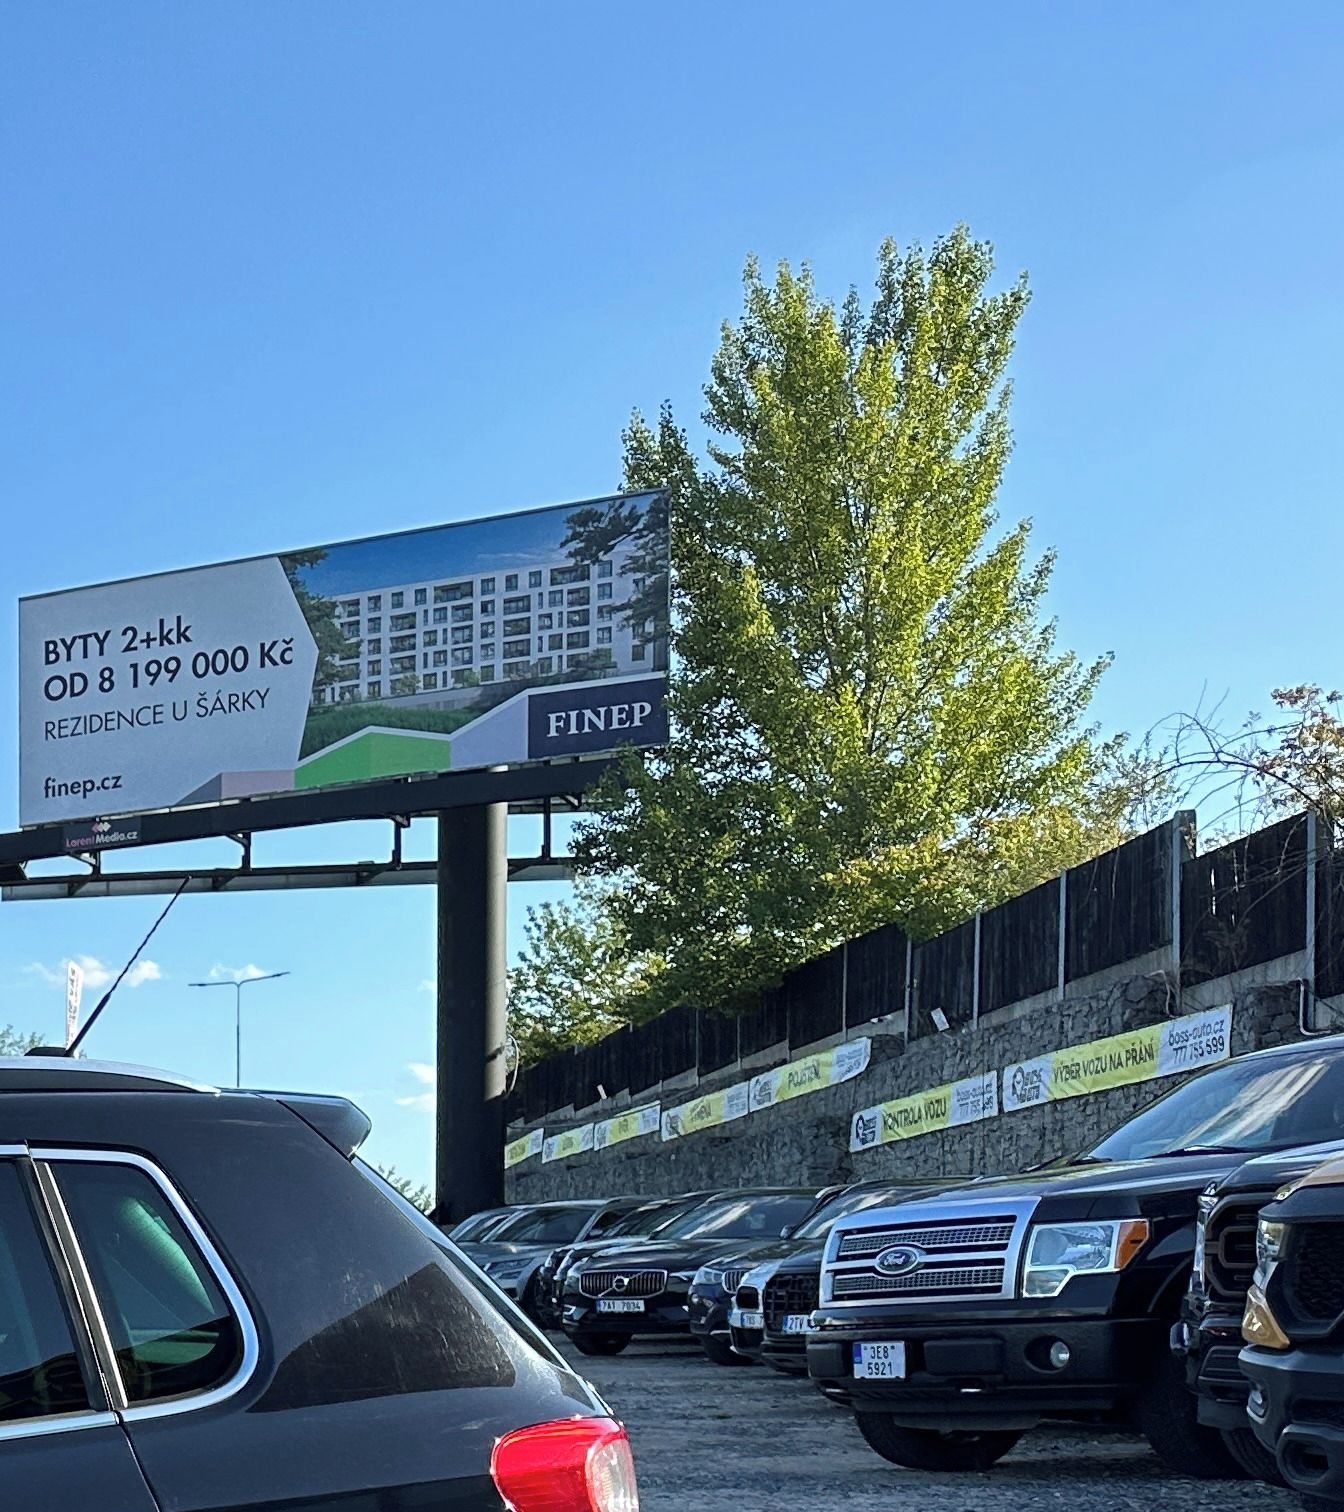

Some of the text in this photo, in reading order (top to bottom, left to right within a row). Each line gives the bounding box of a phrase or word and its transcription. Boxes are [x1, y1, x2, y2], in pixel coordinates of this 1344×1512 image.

[44, 615, 193, 666] BYTY 2+kk
[44, 637, 294, 701] OD 8 199 000 Kč
[45, 687, 270, 741] REZIDENCE U ŠÁRKY
[546, 701, 652, 738] FINEP
[44, 775, 122, 799] finep.cz
[1054, 1057, 1081, 1084] VÝBĚR
[1082, 1055, 1108, 1078] VOZU
[1109, 1054, 1124, 1072] NA
[924, 1097, 947, 1120] VOZU
[883, 1253, 906, 1266] Ford
[870, 1345, 890, 1361] 3E8
[867, 1362, 893, 1377] 5921
